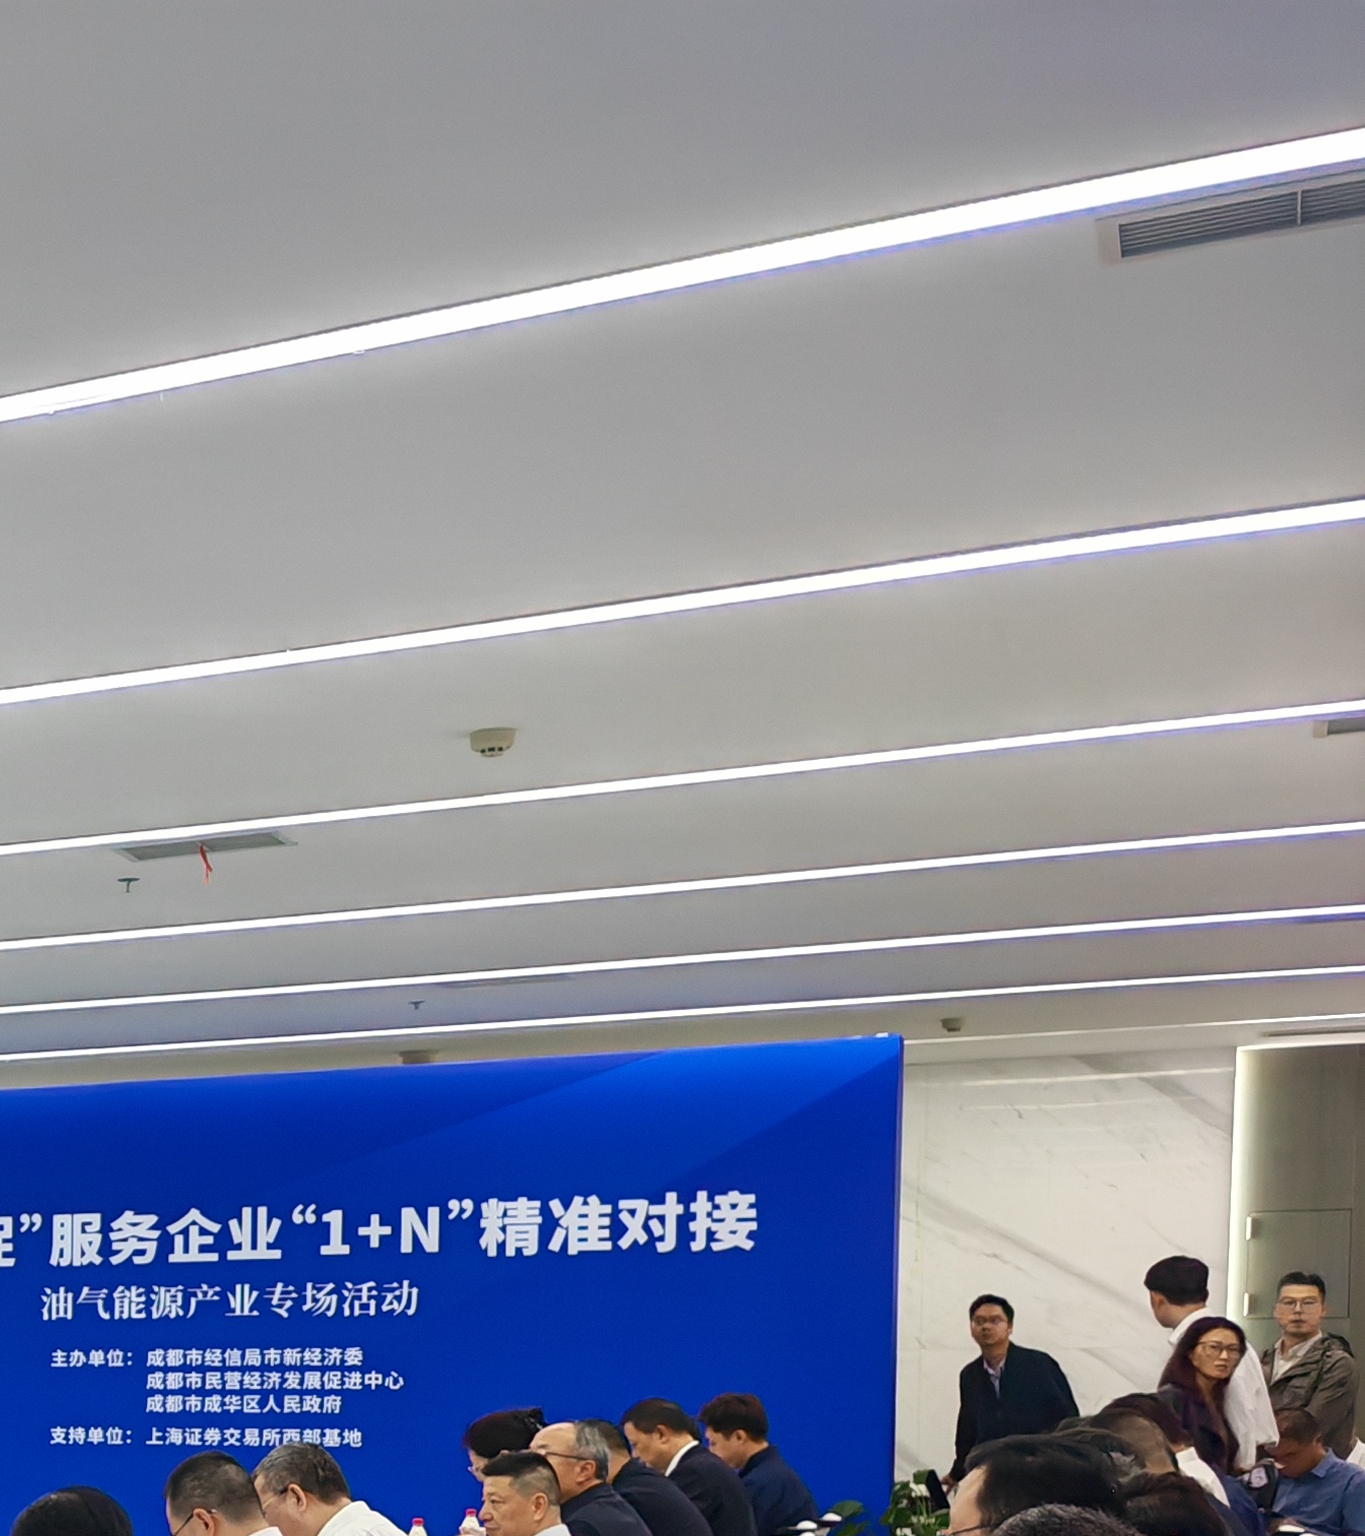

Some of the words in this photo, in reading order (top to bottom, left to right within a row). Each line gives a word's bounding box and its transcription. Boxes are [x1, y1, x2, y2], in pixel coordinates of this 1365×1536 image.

[40, 1280, 419, 1321] 油气能源产业专场活动
[51, 1349, 133, 1368] 主办单位：
[145, 1347, 364, 1368] 成都市经信局市新经济委
[145, 1370, 405, 1391] 成都市民营经济发展促进中心
[145, 1394, 343, 1414] 成都市成华区人民政府
[50, 1426, 132, 1446] 支持单位：
[145, 1427, 363, 1447] 上海证券交易所西部基地
